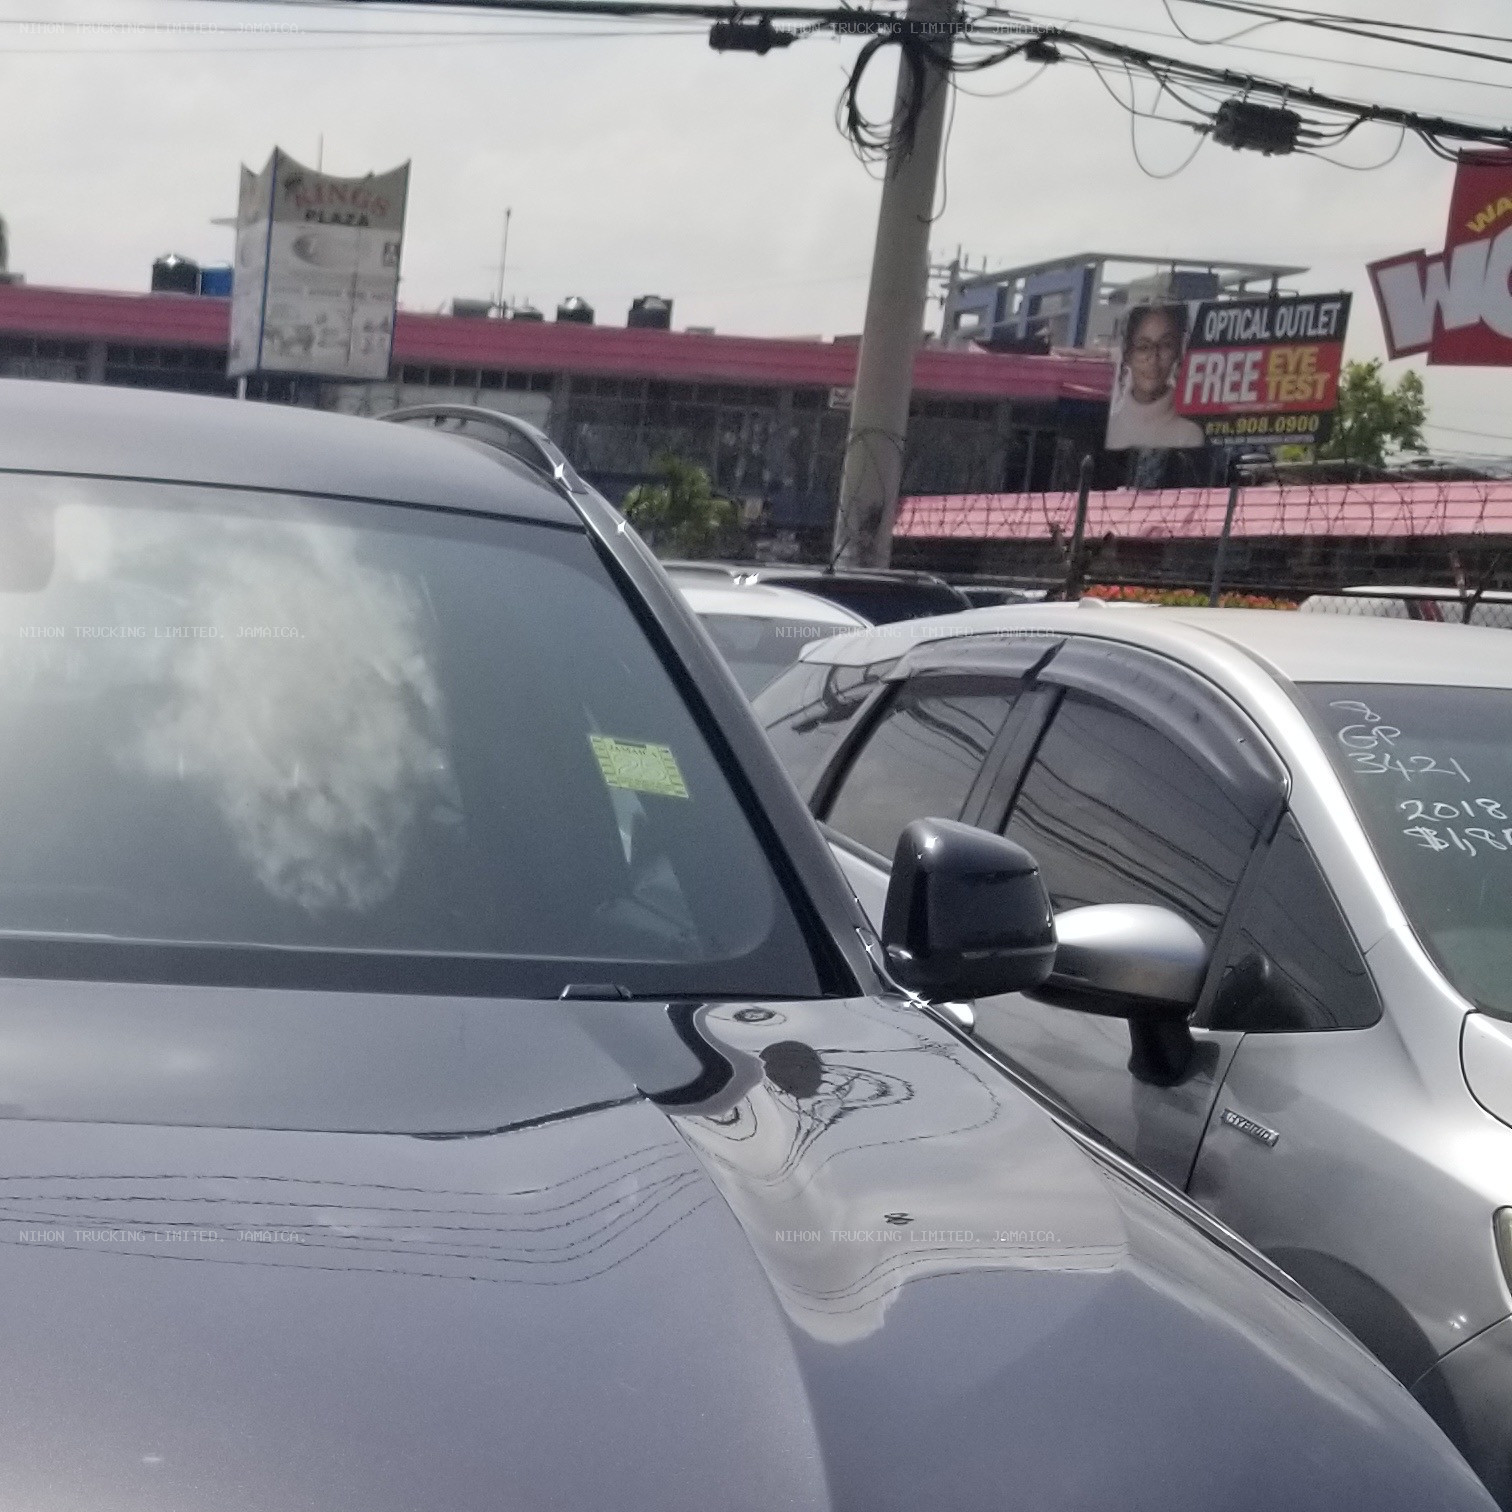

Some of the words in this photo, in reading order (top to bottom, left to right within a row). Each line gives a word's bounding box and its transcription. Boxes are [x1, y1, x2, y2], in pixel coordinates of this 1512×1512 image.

[295, 183, 392, 218] KINGS
[305, 208, 370, 227] PLAZA
[1204, 307, 1271, 341] OPTICAL
[1274, 302, 1341, 336] OUTLET
[1267, 347, 1319, 373] EYE
[1183, 350, 1263, 404] FREE
[1265, 372, 1330, 401] TEST
[1348, 752, 1472, 783] 3421
[1399, 798, 1508, 823] 2018
[1226, 1111, 1270, 1140] HYBRID
